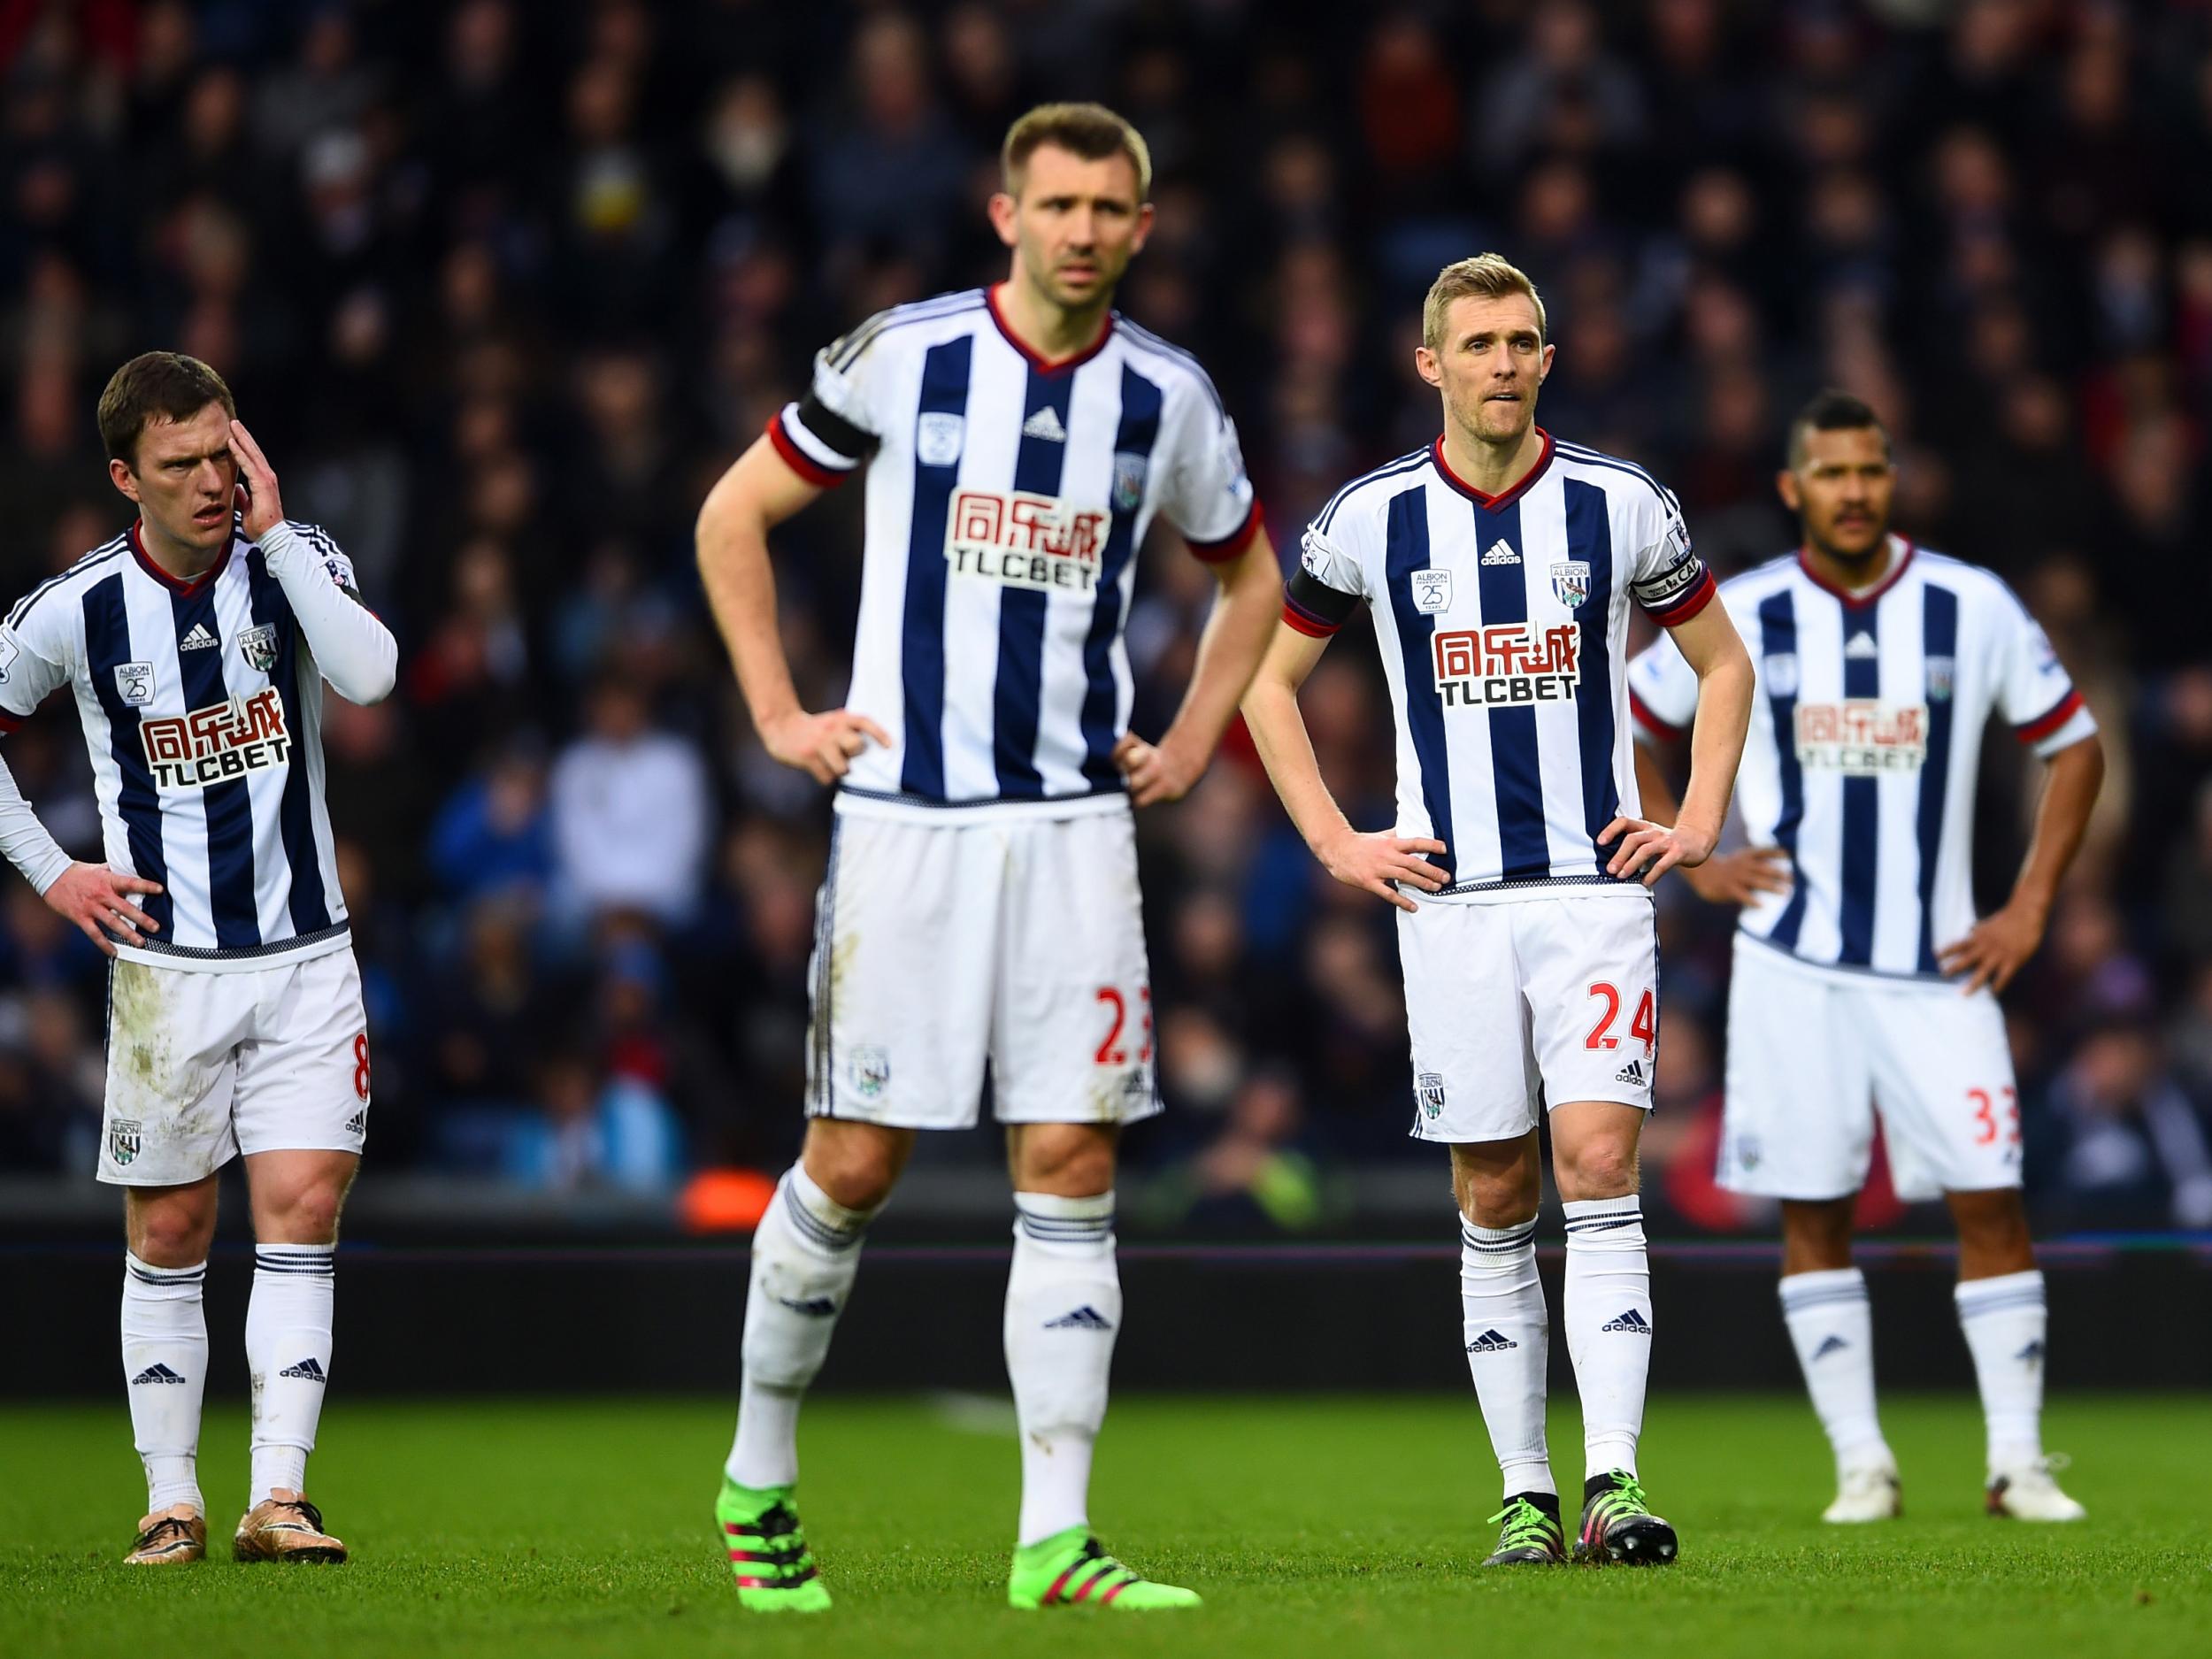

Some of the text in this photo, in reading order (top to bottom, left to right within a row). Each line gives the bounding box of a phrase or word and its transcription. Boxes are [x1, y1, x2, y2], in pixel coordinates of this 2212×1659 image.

[954, 546, 1092, 590] TLCBET
[1480, 556, 1521, 565] adidas
[1422, 585, 1443, 605] 25
[180, 638, 219, 651] adidas
[242, 629, 274, 646] ALBION
[1435, 624, 1577, 680] 同乐城
[126, 678, 147, 697] 25
[1440, 675, 1577, 706] TLCBET
[153, 738, 287, 787] TLCBET
[1804, 749, 1918, 769] TLCBET
[1583, 979, 1655, 1061] 24
[353, 1033, 371, 1102] 8
[1615, 1074, 1647, 1087] adidas
[1601, 1323, 1651, 1335] adidas
[1466, 1340, 1517, 1353] adidas
[132, 1376, 186, 1386] adidas
[280, 1369, 326, 1384] adidas
